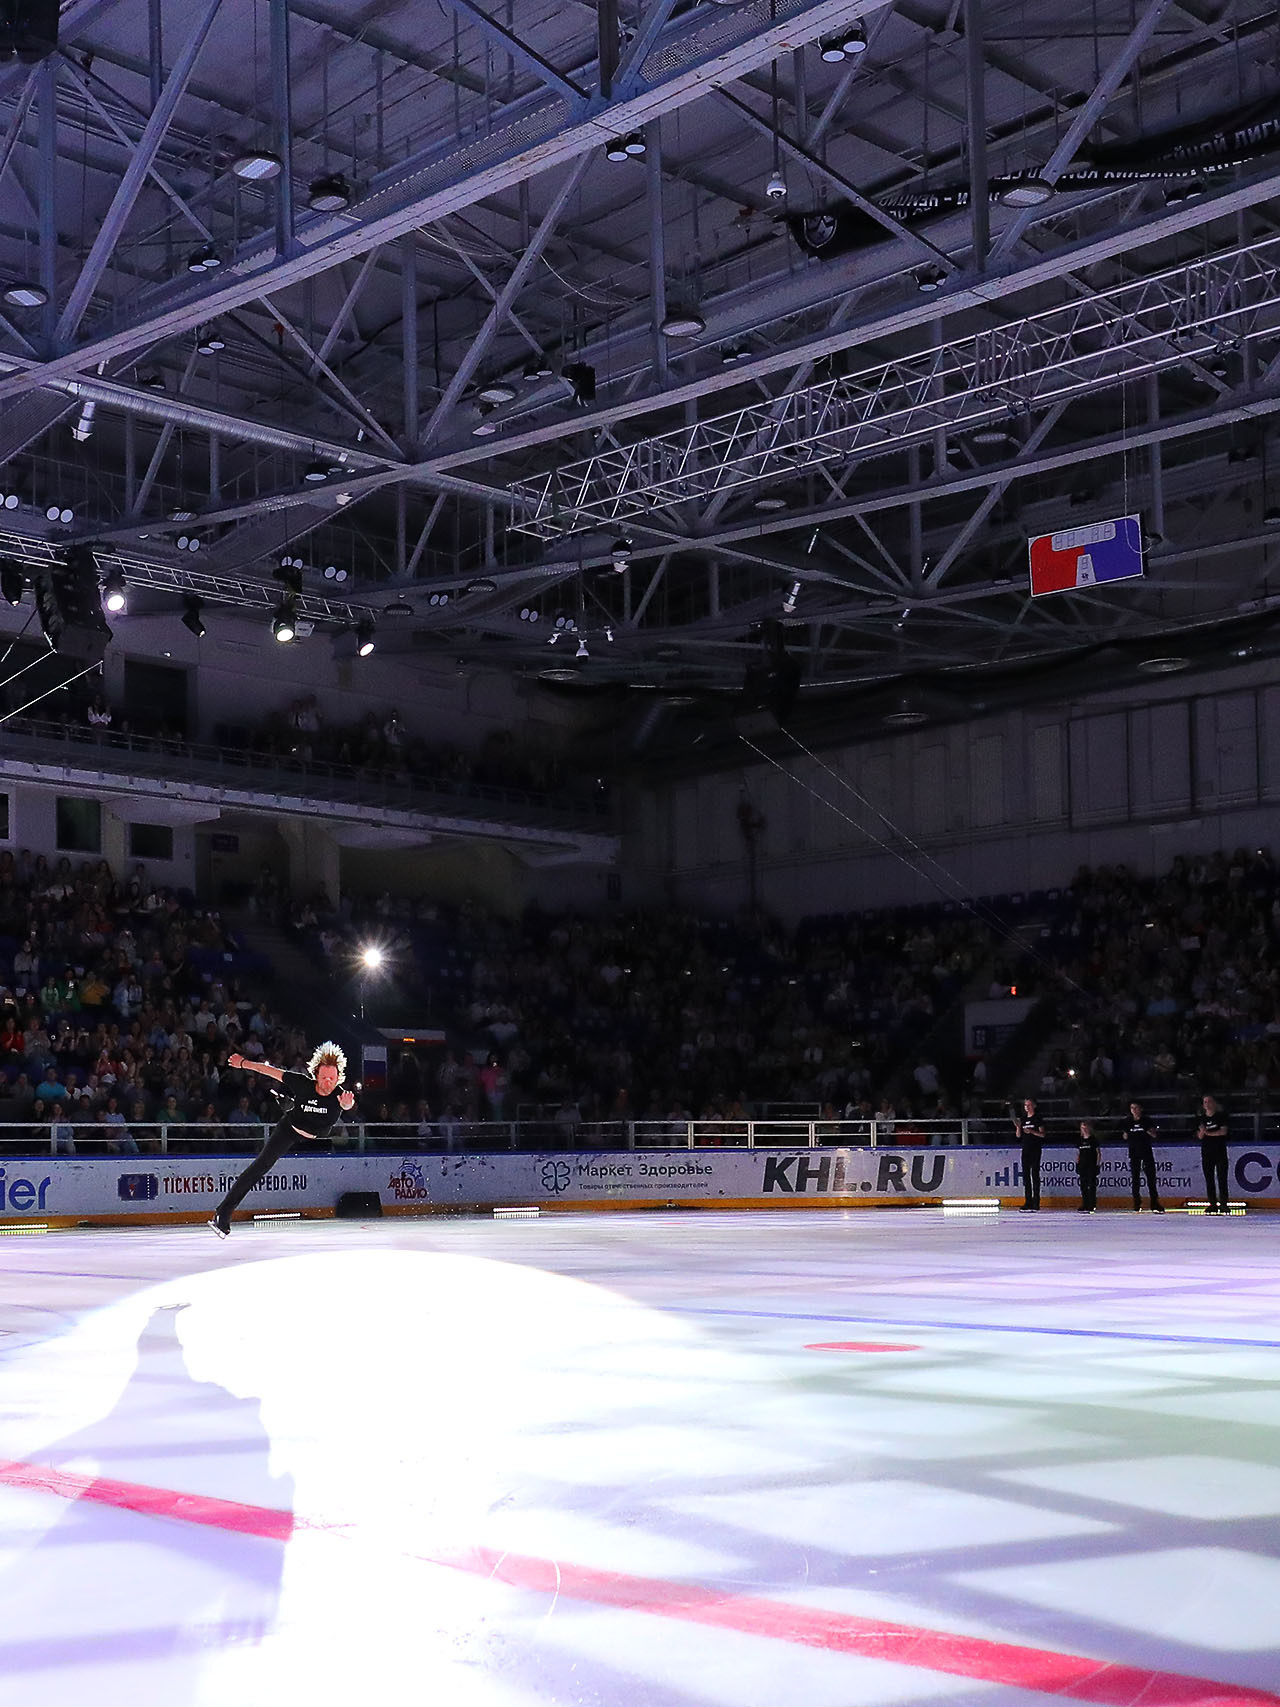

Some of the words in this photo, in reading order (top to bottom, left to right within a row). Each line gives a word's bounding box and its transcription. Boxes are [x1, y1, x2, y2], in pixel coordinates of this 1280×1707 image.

[579, 1163, 633, 1178] Маркет
[639, 1163, 713, 1177] Здоровье
[762, 1154, 946, 1193] KHL.RU
